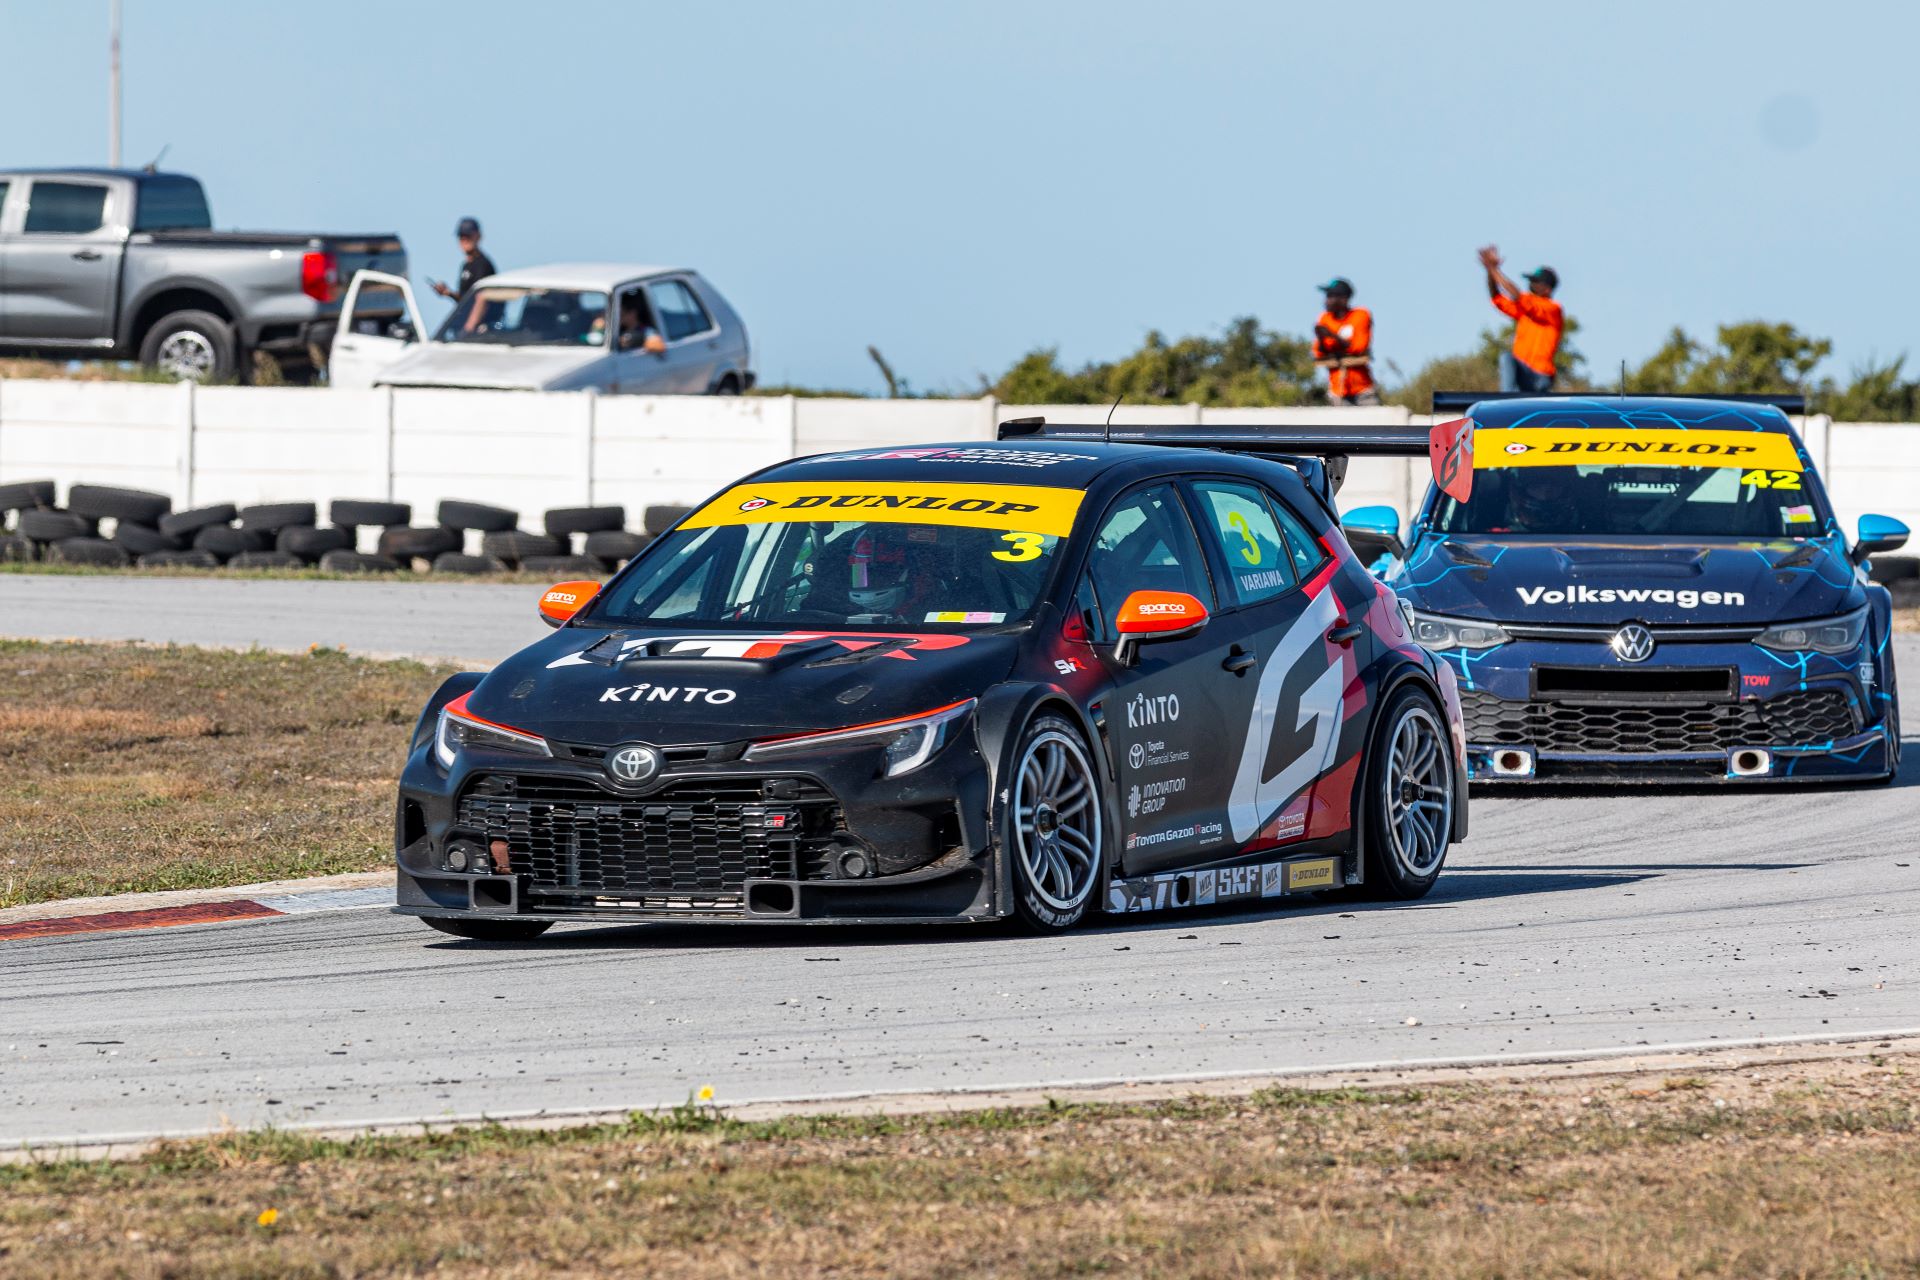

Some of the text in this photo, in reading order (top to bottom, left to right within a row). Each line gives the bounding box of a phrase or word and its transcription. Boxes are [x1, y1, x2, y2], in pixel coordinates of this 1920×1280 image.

[1545, 441, 1756, 456] DUNLOP
[1740, 469, 1801, 490] 42
[780, 495, 1040, 515] DUNLOP
[991, 532, 1044, 562] 3
[1228, 511, 1262, 566] 3
[1240, 570, 1284, 591] VARIAWA
[1516, 585, 1745, 608] Volkswagen
[1138, 602, 1185, 614] sparco
[1743, 675, 1770, 686] TOW
[1147, 741, 1165, 753] Toyota
[1147, 750, 1189, 766] Financial Services
[1143, 778, 1185, 798] INNOVATION
[1142, 797, 1166, 814] GROUP
[1135, 833, 1166, 847] TOYOTA
[1194, 822, 1222, 835] Racing
[1199, 872, 1212, 893] WIX
[1218, 865, 1260, 896] SKF
[1265, 865, 1279, 886] WIX
[1298, 867, 1330, 880] DUNLOP
